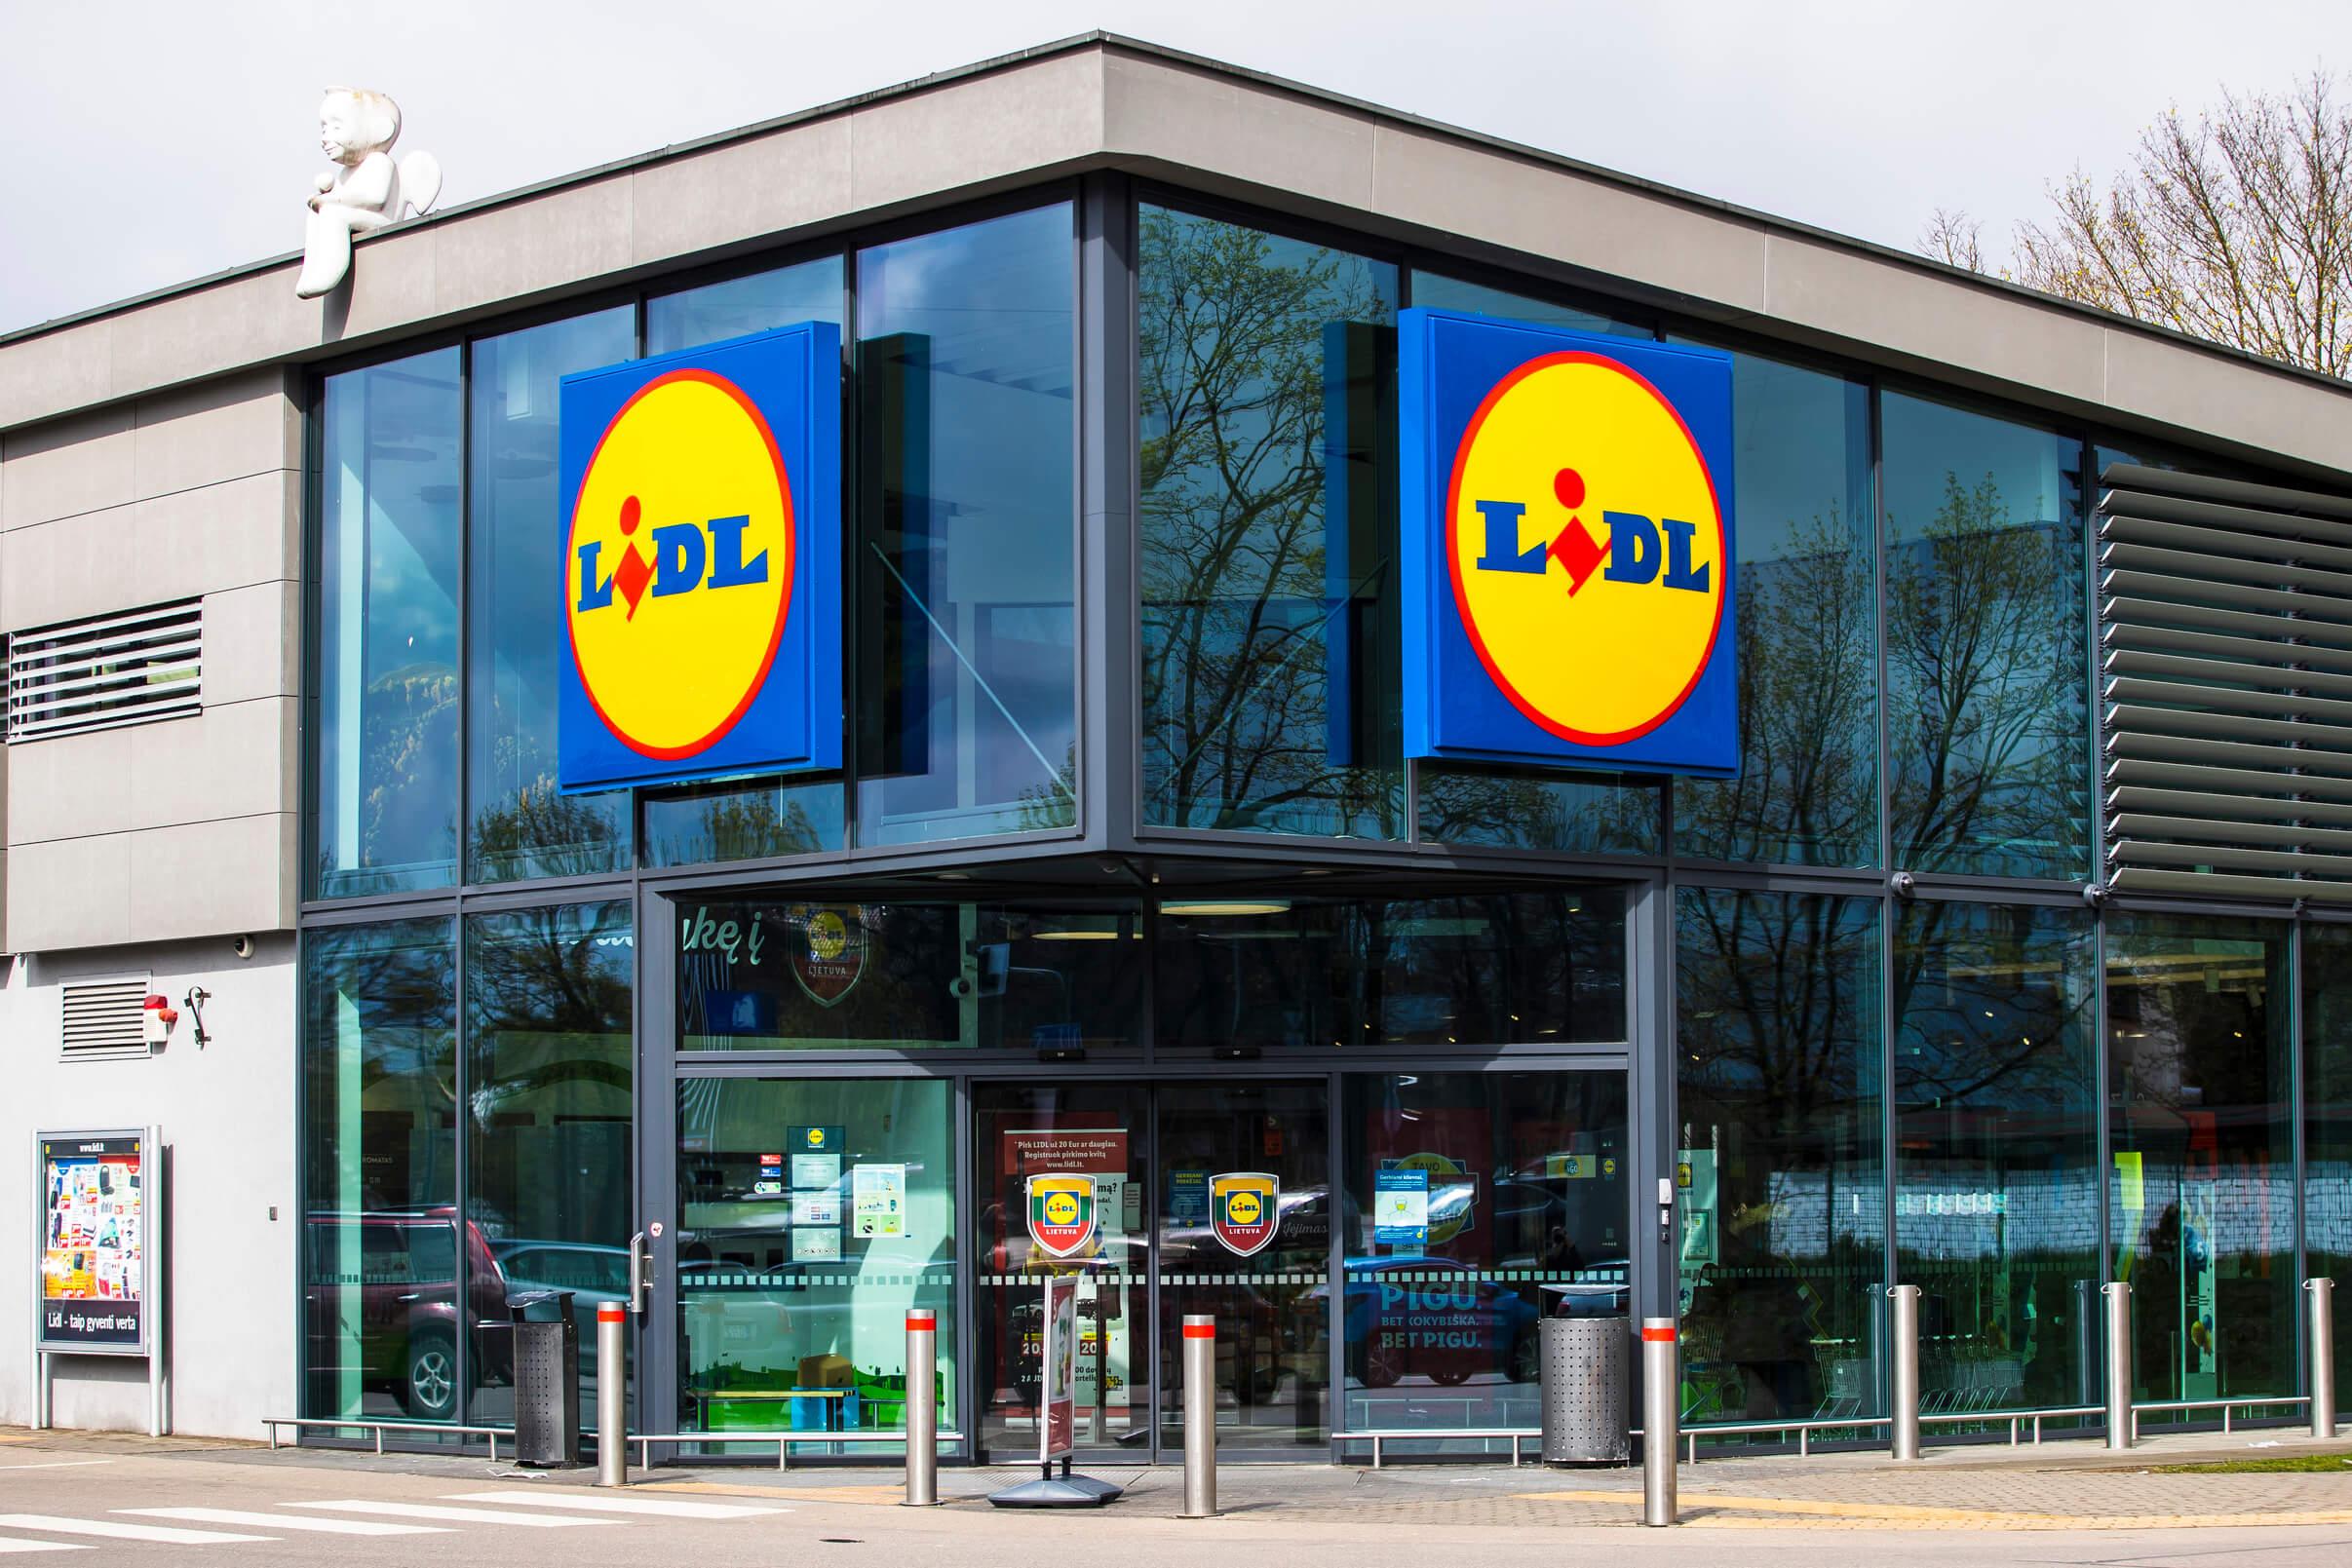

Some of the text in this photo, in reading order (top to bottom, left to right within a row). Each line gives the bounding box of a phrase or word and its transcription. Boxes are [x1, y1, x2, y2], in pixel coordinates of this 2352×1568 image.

[808, 966, 846, 976] LIETUVA
[1061, 1150, 1089, 1159] pirkimo
[1411, 1162, 1441, 1172] TAVO
[1379, 1281, 1482, 1311] PIGU.
[48, 1312, 62, 1327] Lidl
[69, 1313, 85, 1332] taip
[86, 1313, 114, 1333] gyventi
[115, 1315, 136, 1330] verta
[1381, 1317, 1404, 1326] BET
[1380, 1331, 1482, 1349] BET PIGU.
